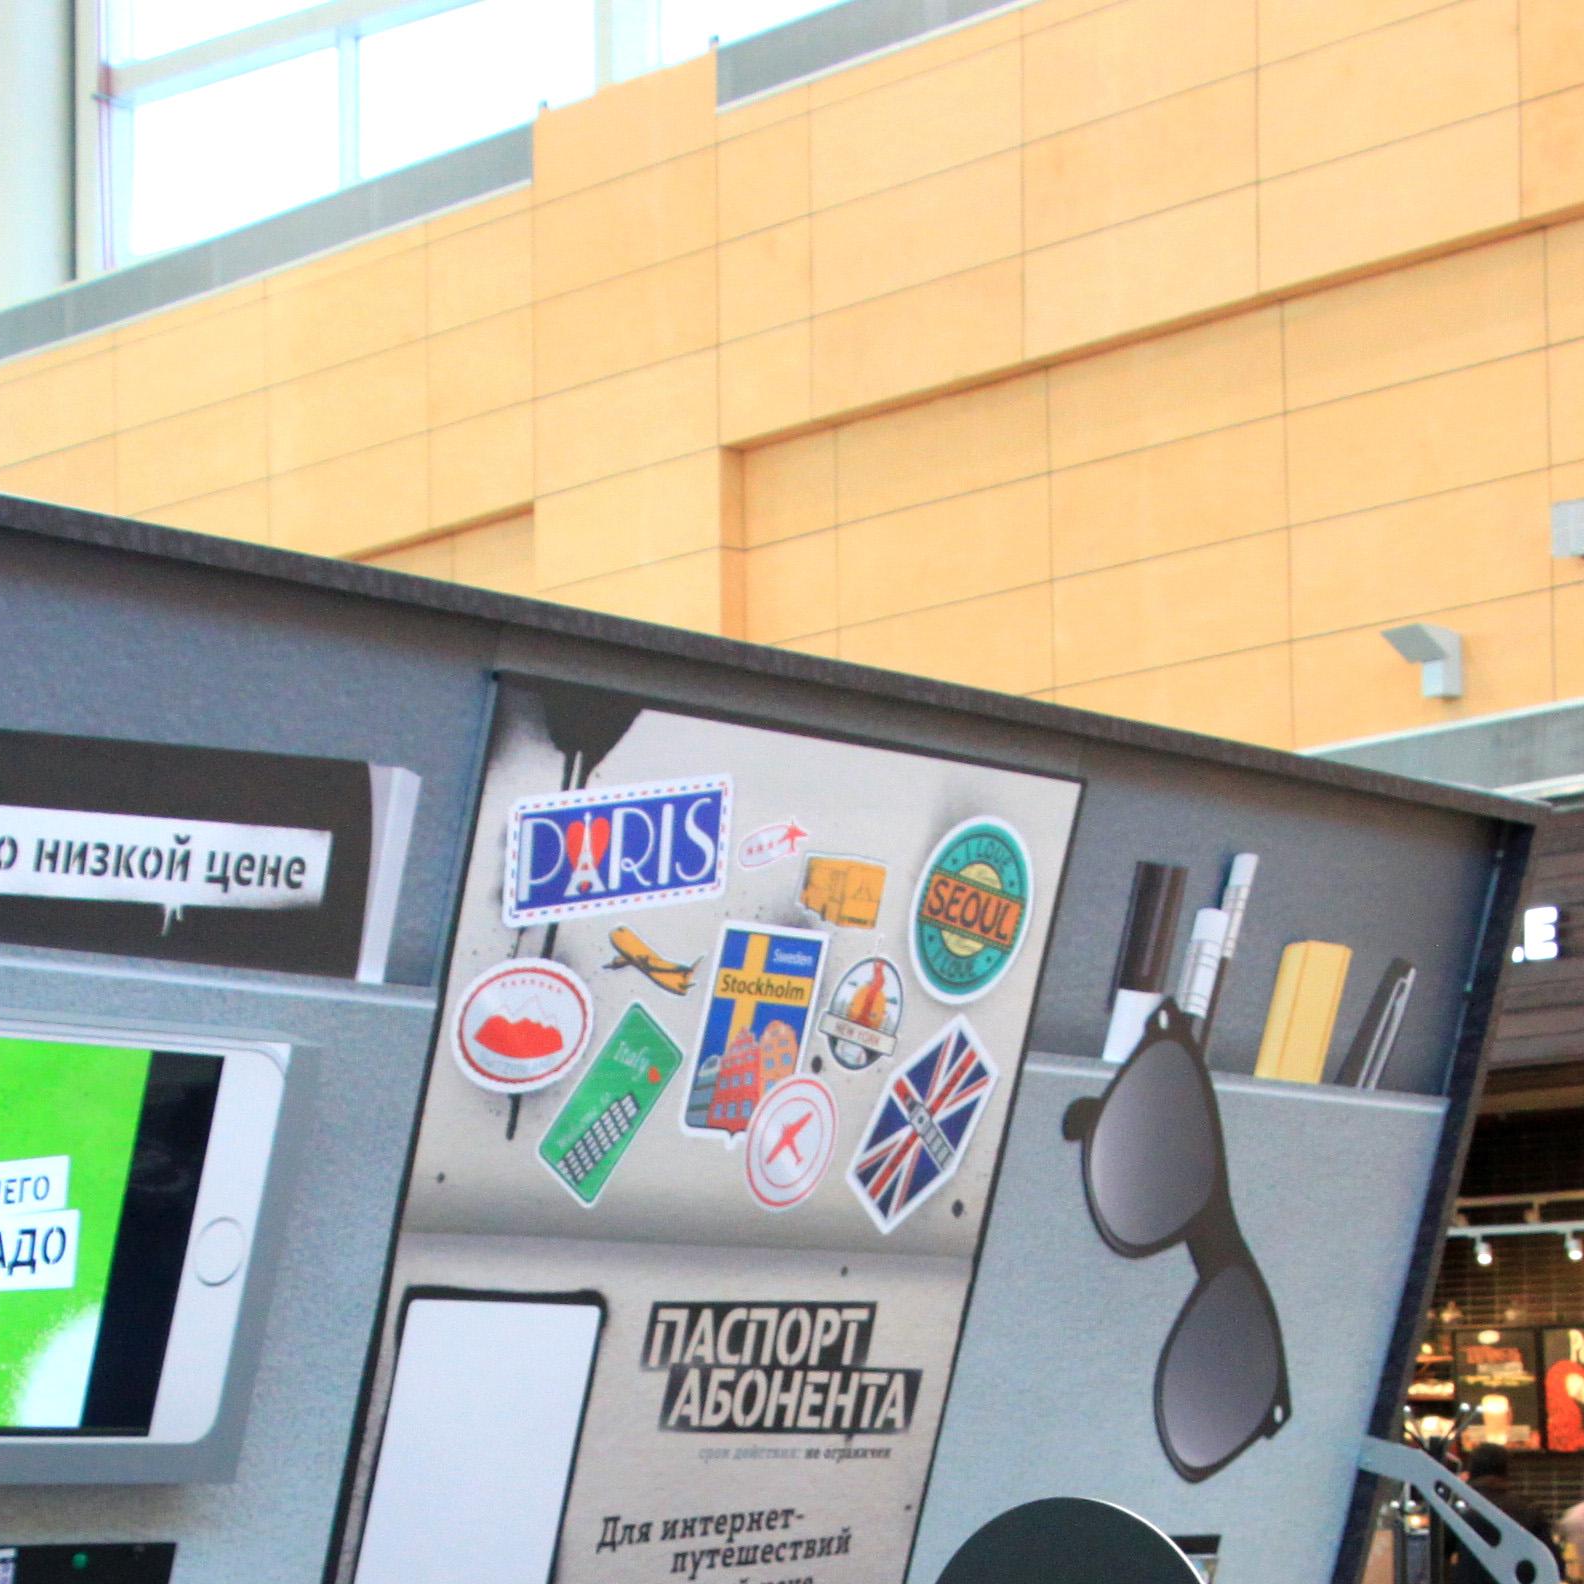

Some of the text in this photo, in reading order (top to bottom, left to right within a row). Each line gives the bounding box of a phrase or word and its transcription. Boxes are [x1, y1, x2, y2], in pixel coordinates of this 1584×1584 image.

[32, 833, 193, 883] низкой
[204, 849, 307, 893] цене
[518, 797, 715, 902] PARIS
[927, 879, 1011, 941] SEOUL
[721, 973, 806, 1000] Stockholm
[773, 948, 813, 966] Sweden
[647, 1306, 871, 1367] ПАСПОРТ
[666, 1367, 906, 1429] АБОНЕНТА
[596, 1508, 805, 1554] Для интернет-
[669, 1526, 853, 1581] путешествий
